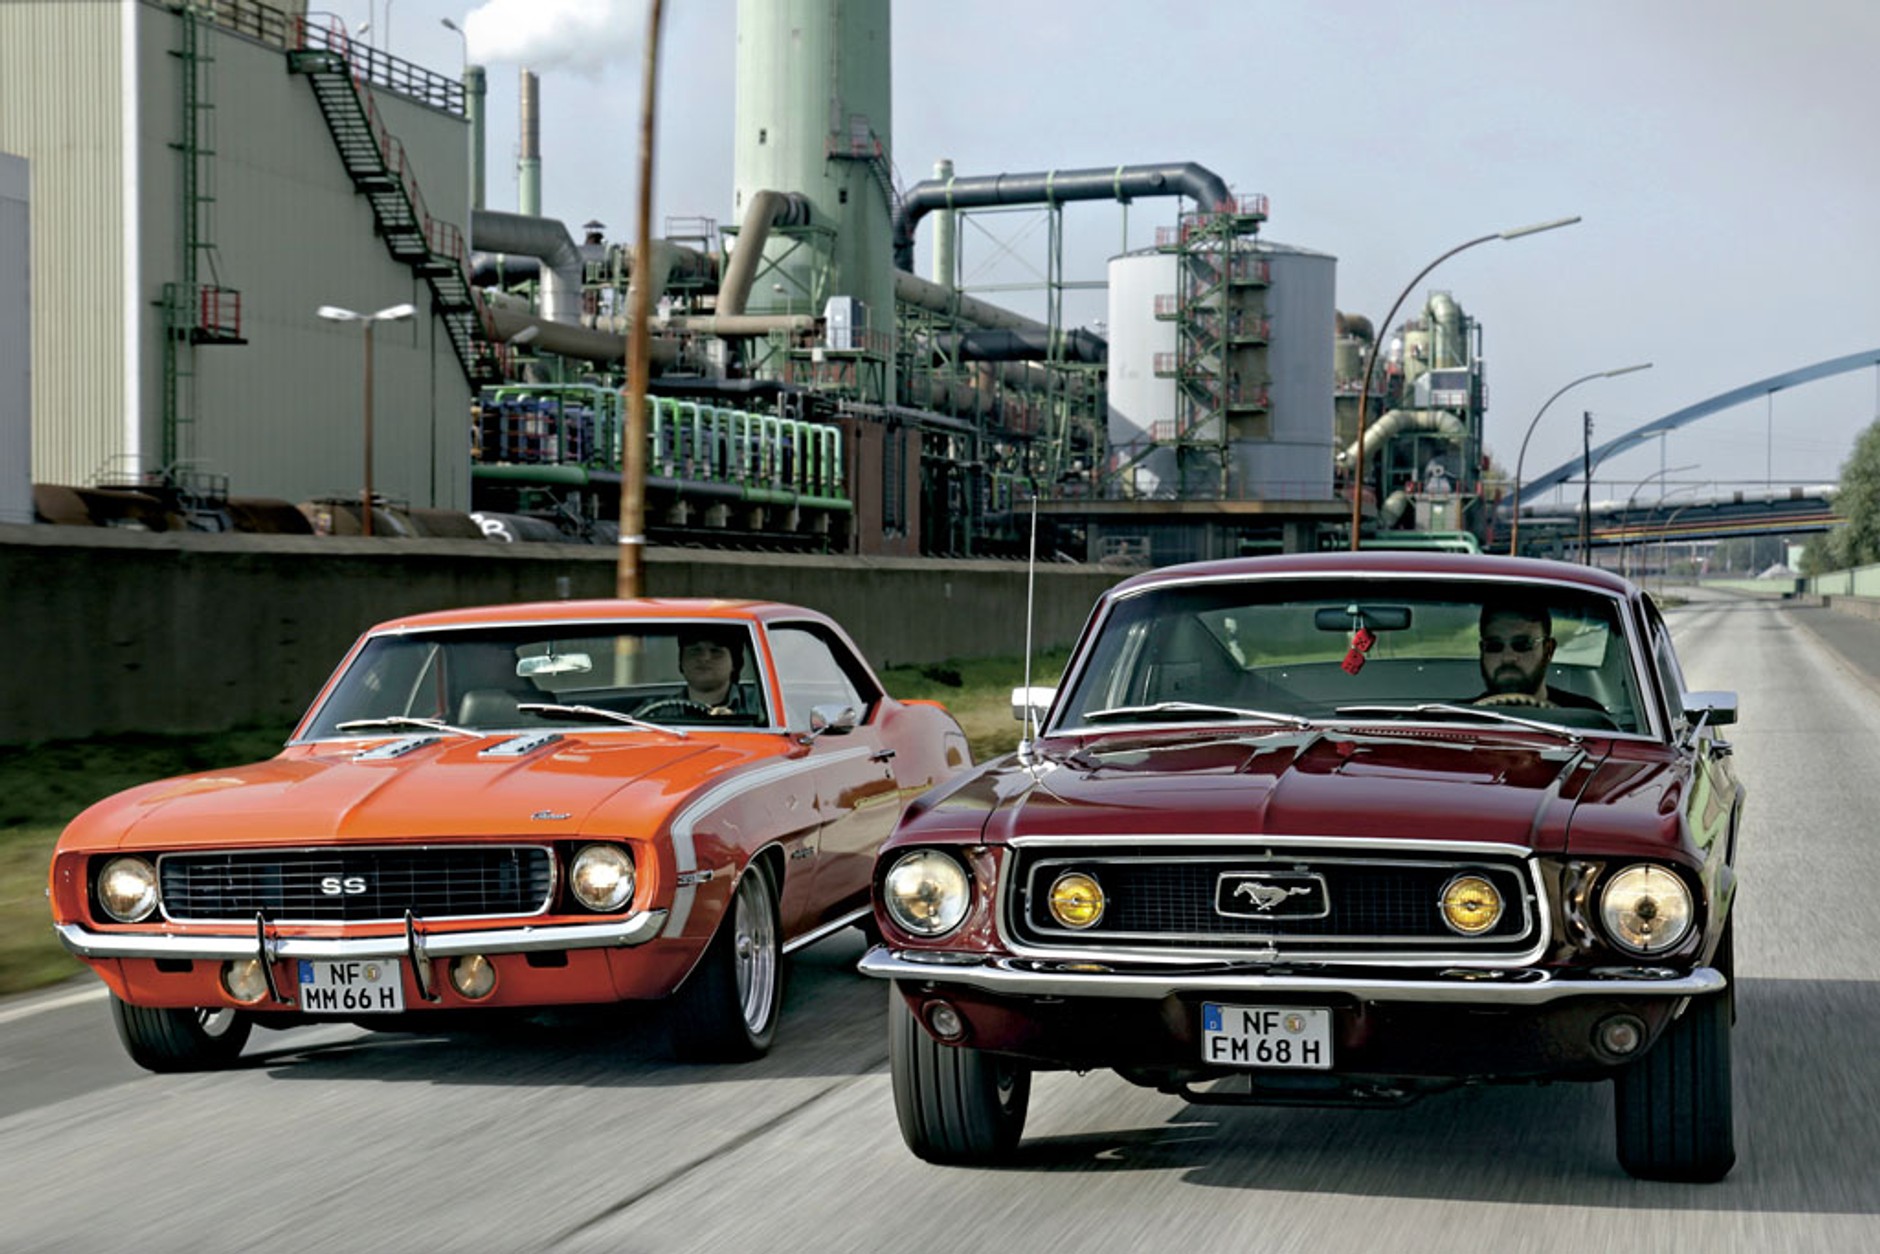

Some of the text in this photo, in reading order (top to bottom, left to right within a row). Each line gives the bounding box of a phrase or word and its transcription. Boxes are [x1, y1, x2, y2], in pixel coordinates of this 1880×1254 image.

[321, 877, 366, 895] SS
[330, 963, 360, 985] NF
[305, 986, 395, 1009] MM 66 H
[1242, 1010, 1280, 1035] NF
[1211, 1036, 1320, 1064] FM 68 H
